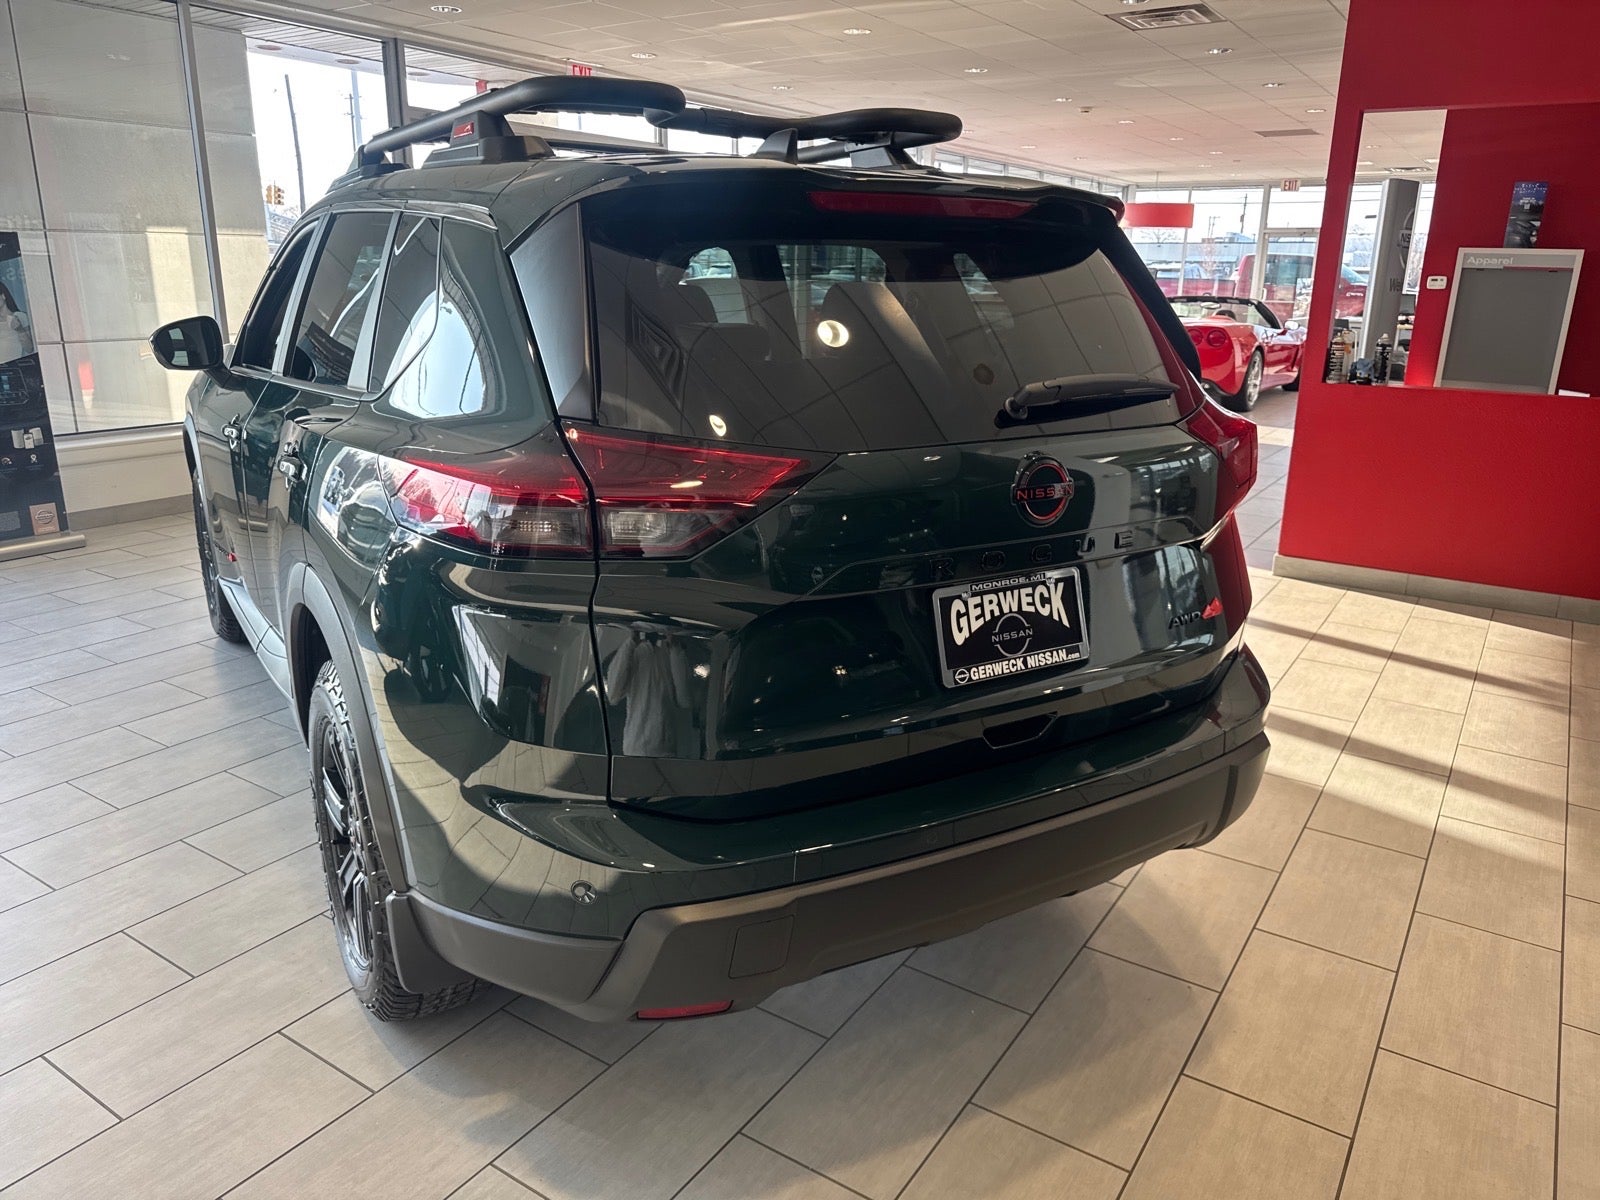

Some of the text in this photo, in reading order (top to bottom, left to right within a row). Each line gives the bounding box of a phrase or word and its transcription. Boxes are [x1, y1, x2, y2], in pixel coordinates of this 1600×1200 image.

[1283, 179, 1298, 191] EXIT
[1466, 256, 1514, 266] Apparel
[1016, 483, 1073, 501] NISSAN
[928, 530, 1134, 577] ROGUE
[1031, 573, 1045, 582] MI
[950, 582, 1070, 646] GERWECK
[991, 628, 1033, 643] NISSAN
[970, 657, 1026, 680] GERWECK
